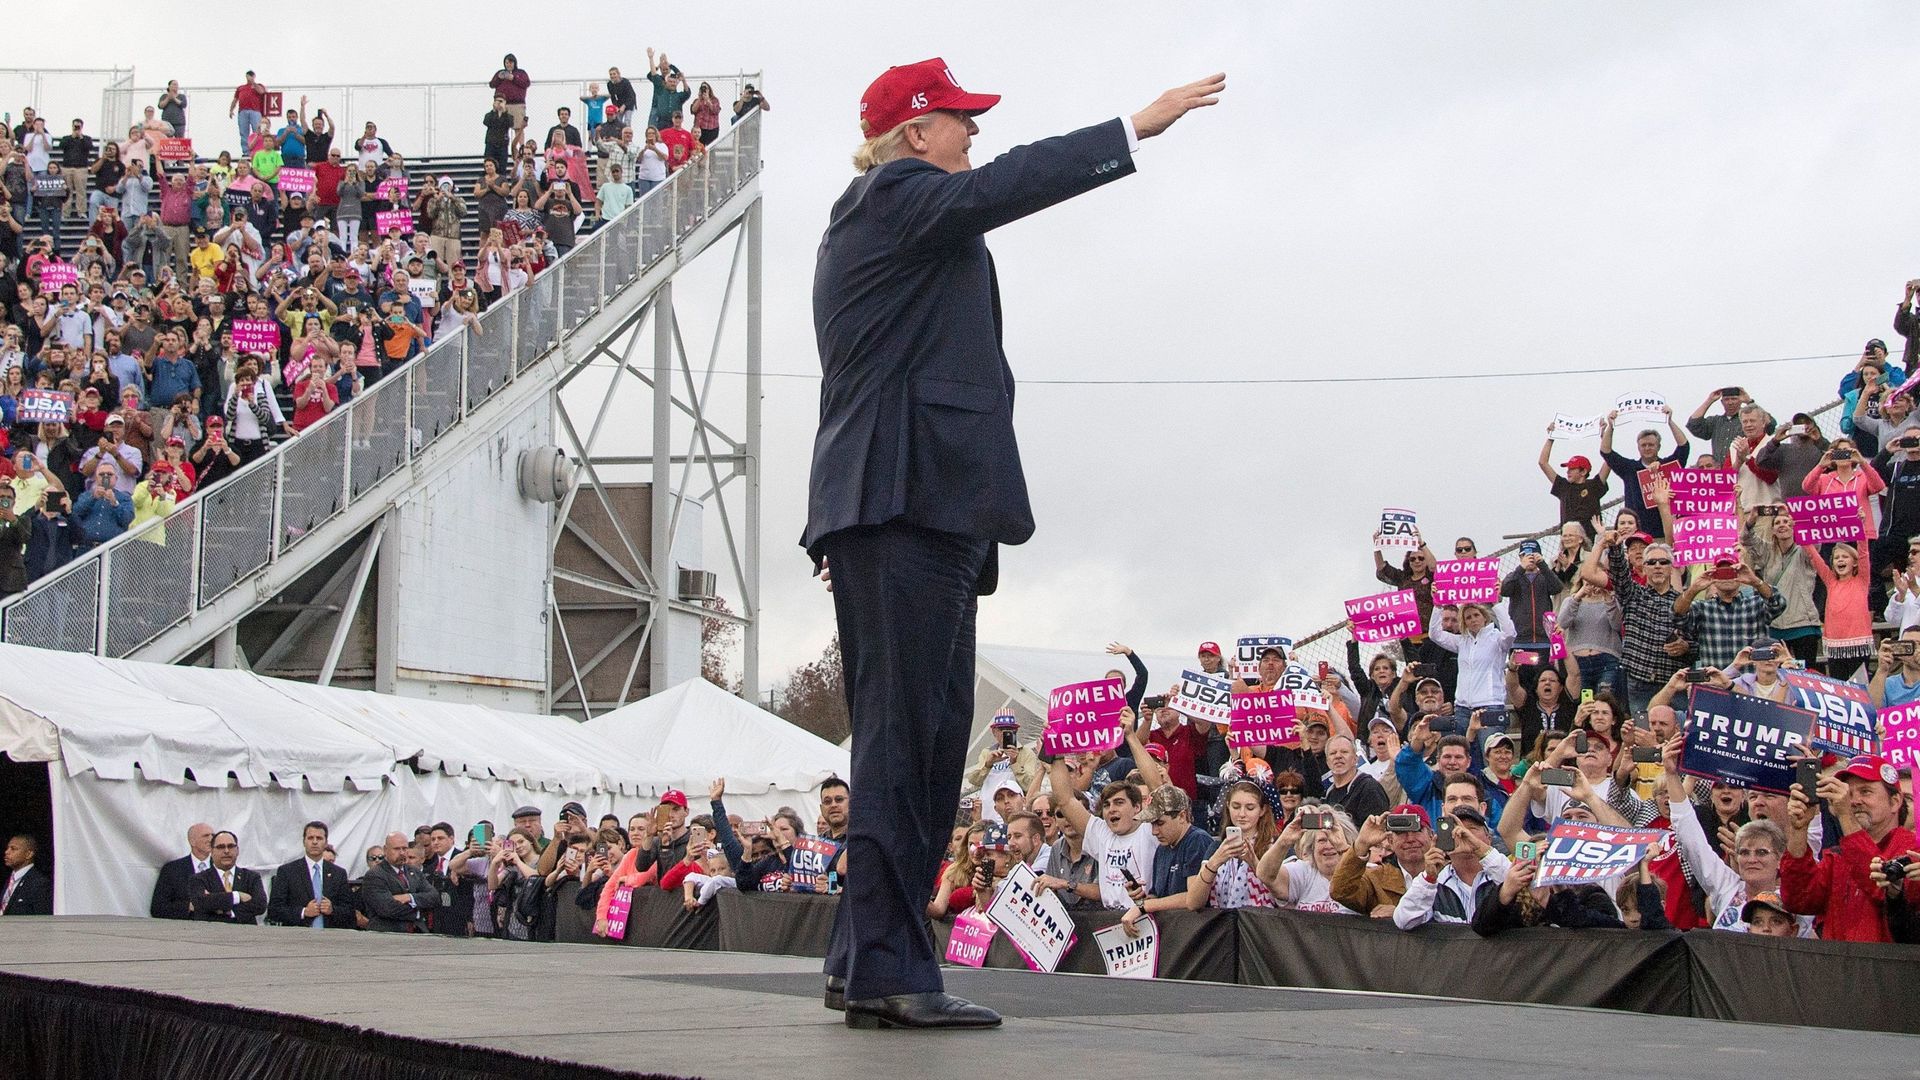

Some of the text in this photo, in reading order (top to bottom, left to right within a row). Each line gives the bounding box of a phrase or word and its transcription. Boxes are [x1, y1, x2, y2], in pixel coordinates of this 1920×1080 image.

[270, 96, 278, 109] K
[911, 92, 928, 110] 45
[281, 169, 316, 177] WOMEN
[281, 182, 313, 191] TRUMP
[376, 211, 412, 219] WOMEN
[41, 264, 77, 273] WOMEN
[233, 322, 276, 332] WOMEN
[234, 340, 273, 350] TRUMP
[25, 397, 67, 413] USA
[1617, 398, 1664, 408] TRUMP
[1671, 471, 1737, 484] WOMEN
[1691, 488, 1716, 496] FOR
[1674, 500, 1733, 512] TRUMP
[1787, 495, 1858, 512] WOMEN
[1673, 518, 1737, 534] WOMEN
[1813, 514, 1838, 524] FOR
[1689, 535, 1713, 544] FOR
[1798, 526, 1860, 541] TRUMP
[1436, 561, 1499, 573] WOMEN
[1454, 576, 1476, 584] FOR
[1437, 588, 1494, 600] TRUMP
[1346, 592, 1414, 615] WOMEN
[1371, 612, 1396, 624] FOR
[1357, 620, 1417, 640] TRUMP
[1050, 684, 1124, 709] WOMEN
[1181, 680, 1231, 707] USA
[1231, 694, 1293, 710] WOMEN
[1798, 687, 1871, 732] USA
[1066, 711, 1097, 725] FOR
[1247, 714, 1272, 725] FOR
[1232, 727, 1293, 743] TRUMP
[1694, 710, 1803, 748] TRUMP
[1897, 728, 1918, 741] FO
[1047, 726, 1123, 749] TRUMP
[1699, 731, 1787, 760] PENCE
[1694, 744, 1788, 771] MAKE AMERICA GREAT AGAIN!
[1725, 778, 1745, 787] 2016
[1583, 823, 1613, 832] AMERICA
[1547, 838, 1637, 863] USA
[793, 849, 824, 873] USA
[614, 889, 632, 903] MEN
[610, 905, 619, 914] OR
[1011, 881, 1064, 942] TRUMP
[1010, 897, 1056, 947] PENCE
[964, 924, 980, 938] FOR
[950, 939, 984, 961] TRUMP
[1106, 935, 1153, 961] TRUMP
[1114, 952, 1149, 971] PENCE
